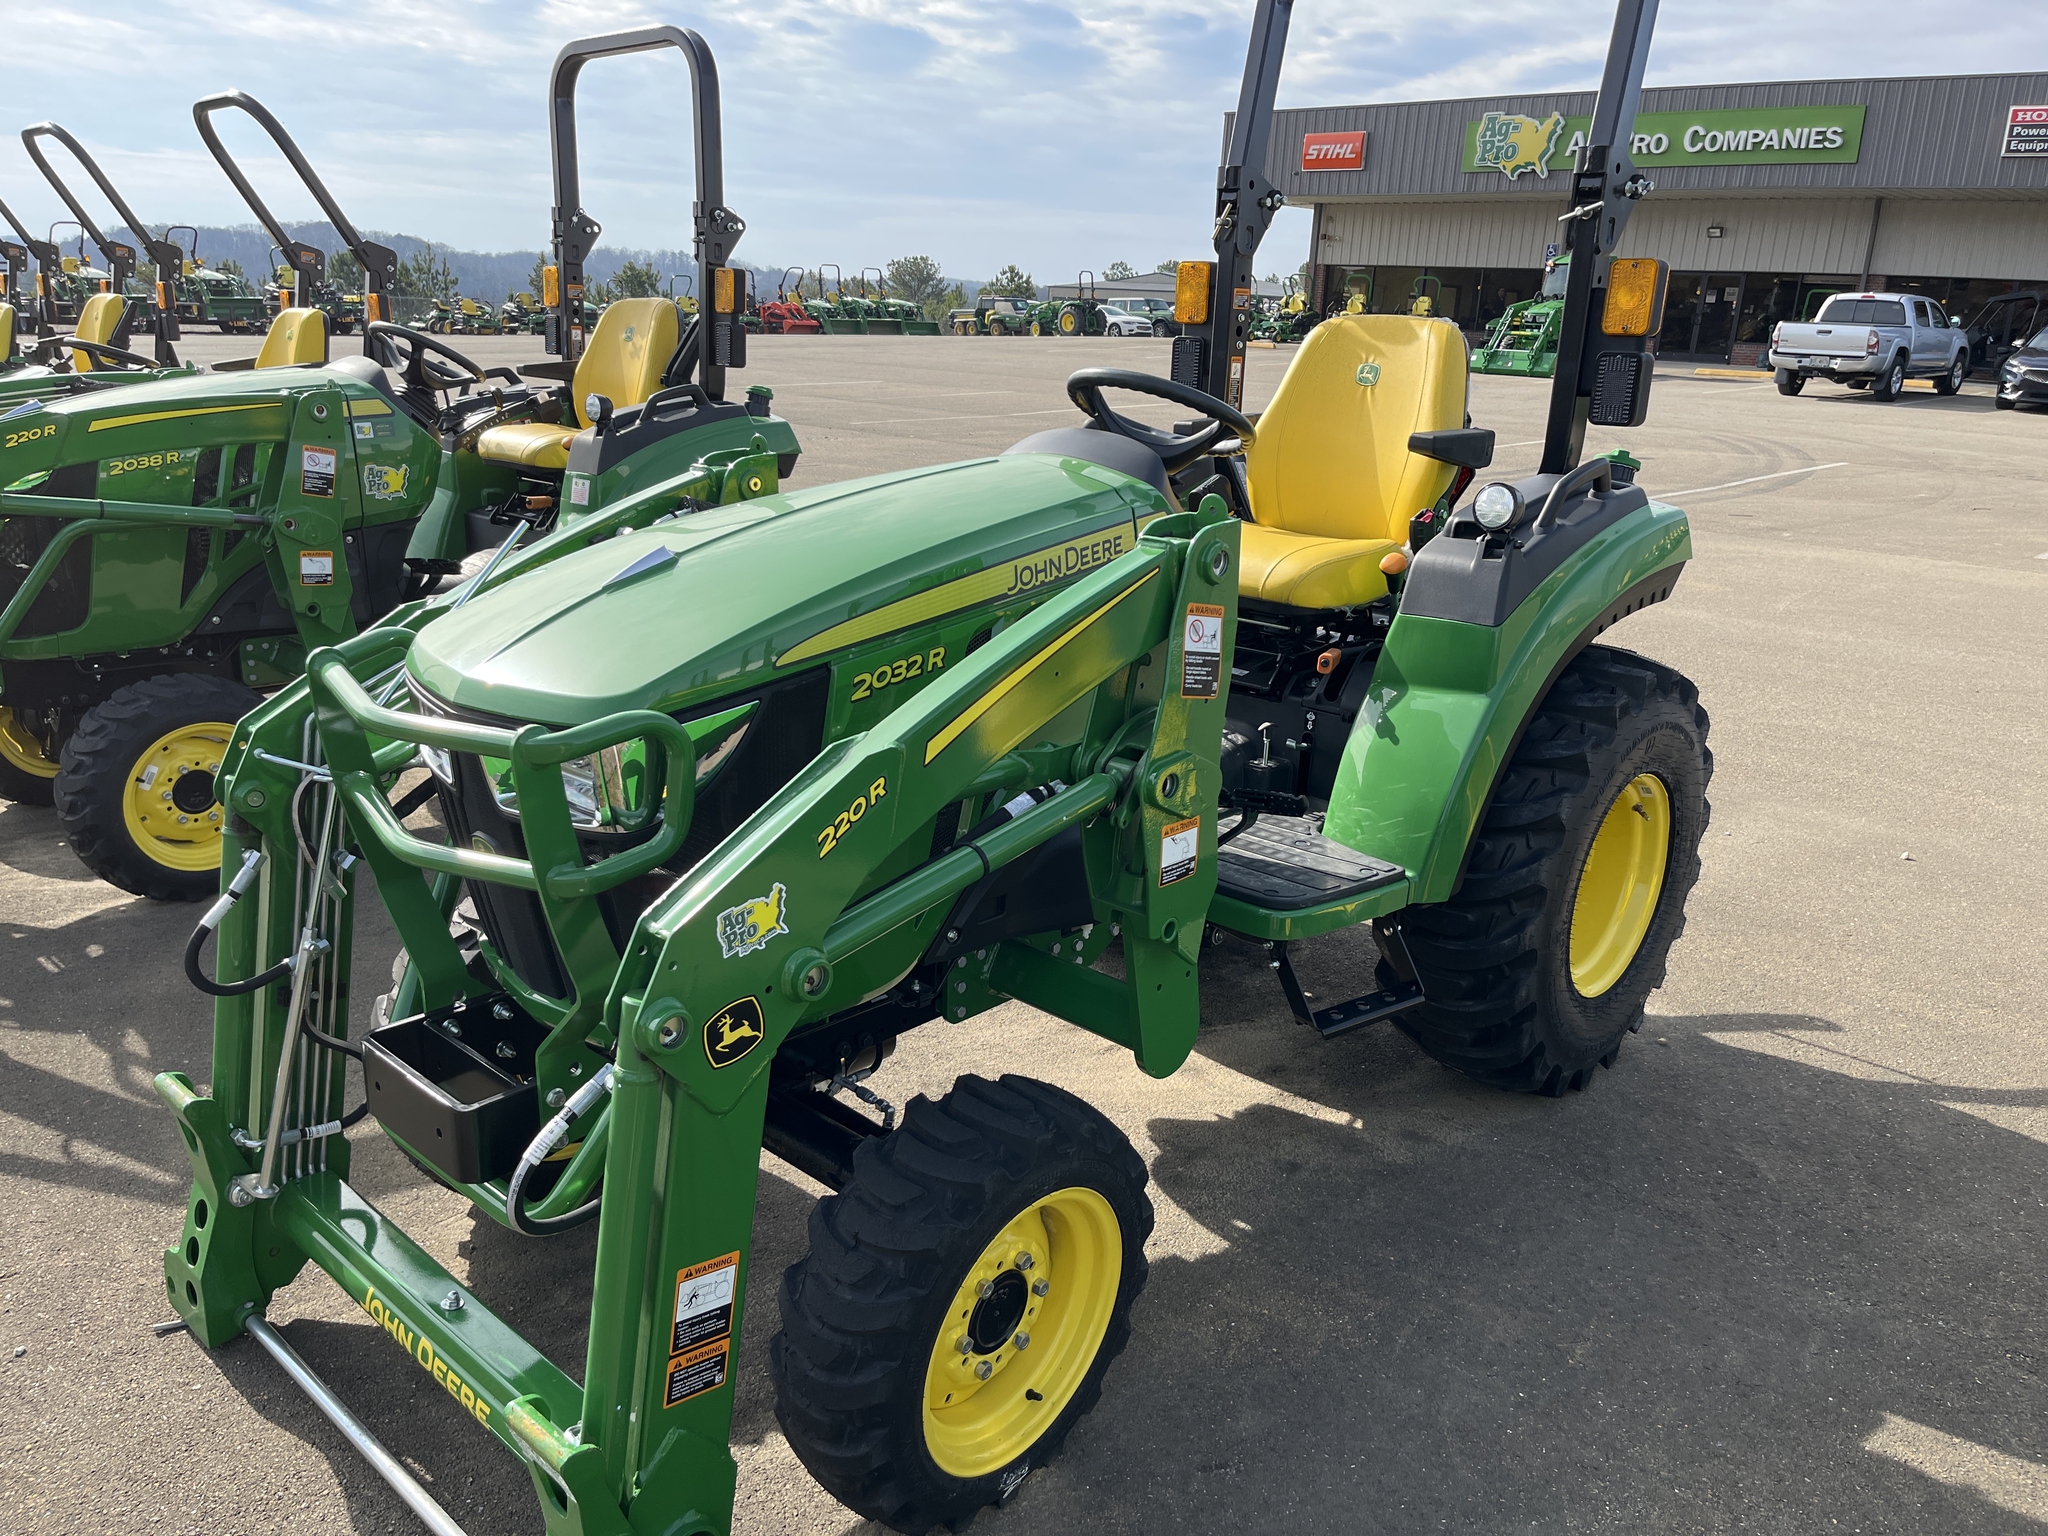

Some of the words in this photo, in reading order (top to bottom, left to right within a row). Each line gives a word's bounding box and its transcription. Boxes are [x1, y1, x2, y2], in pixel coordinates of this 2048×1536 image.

[2015, 110, 2048, 121] HO
[1480, 115, 1521, 142] Ag-
[1683, 125, 1844, 153] COMPANIES
[1478, 141, 1518, 162] Pro
[5, 427, 42, 448] 220
[44, 424, 56, 437] R
[109, 454, 163, 476] 2038
[166, 451, 180, 464] R
[366, 467, 388, 480] Ag-
[368, 480, 389, 492] Pro
[1007, 555, 1062, 592] JOHN
[1065, 535, 1123, 572] DEERE
[1195, 605, 1222, 616] WARNING
[850, 654, 923, 702] 2032
[927, 646, 946, 672] R
[817, 796, 867, 859] 220
[869, 776, 887, 806] R
[1170, 818, 1197, 834] WARNING
[722, 908, 753, 935] Ag-
[724, 923, 758, 953] Pro
[694, 1256, 733, 1275] WARNING
[360, 1286, 413, 1355] JOHN
[417, 1336, 490, 1431] DEERE
[685, 1344, 723, 1364] WARNING
